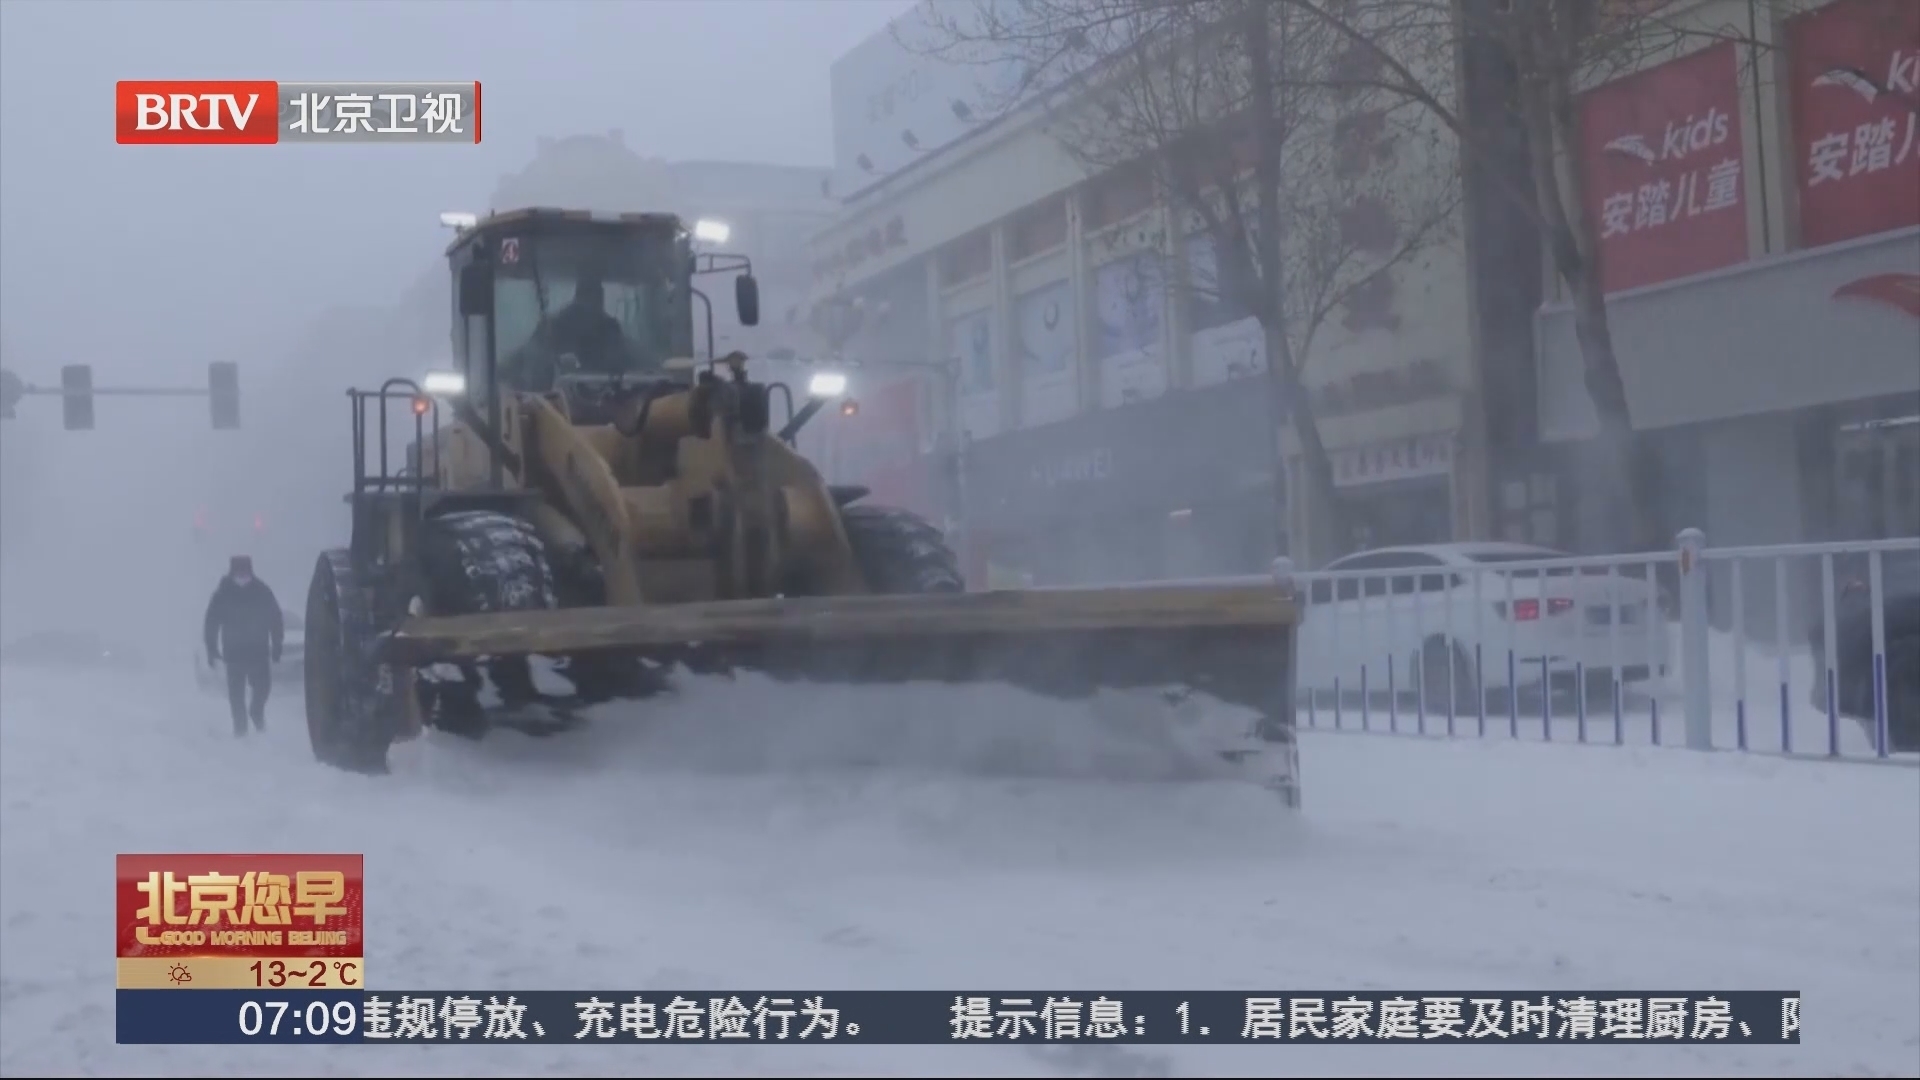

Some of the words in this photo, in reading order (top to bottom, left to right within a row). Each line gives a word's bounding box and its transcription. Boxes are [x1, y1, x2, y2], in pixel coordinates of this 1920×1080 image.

[1661, 106, 1729, 160] kids
[1601, 158, 1740, 239] 安踏儿童
